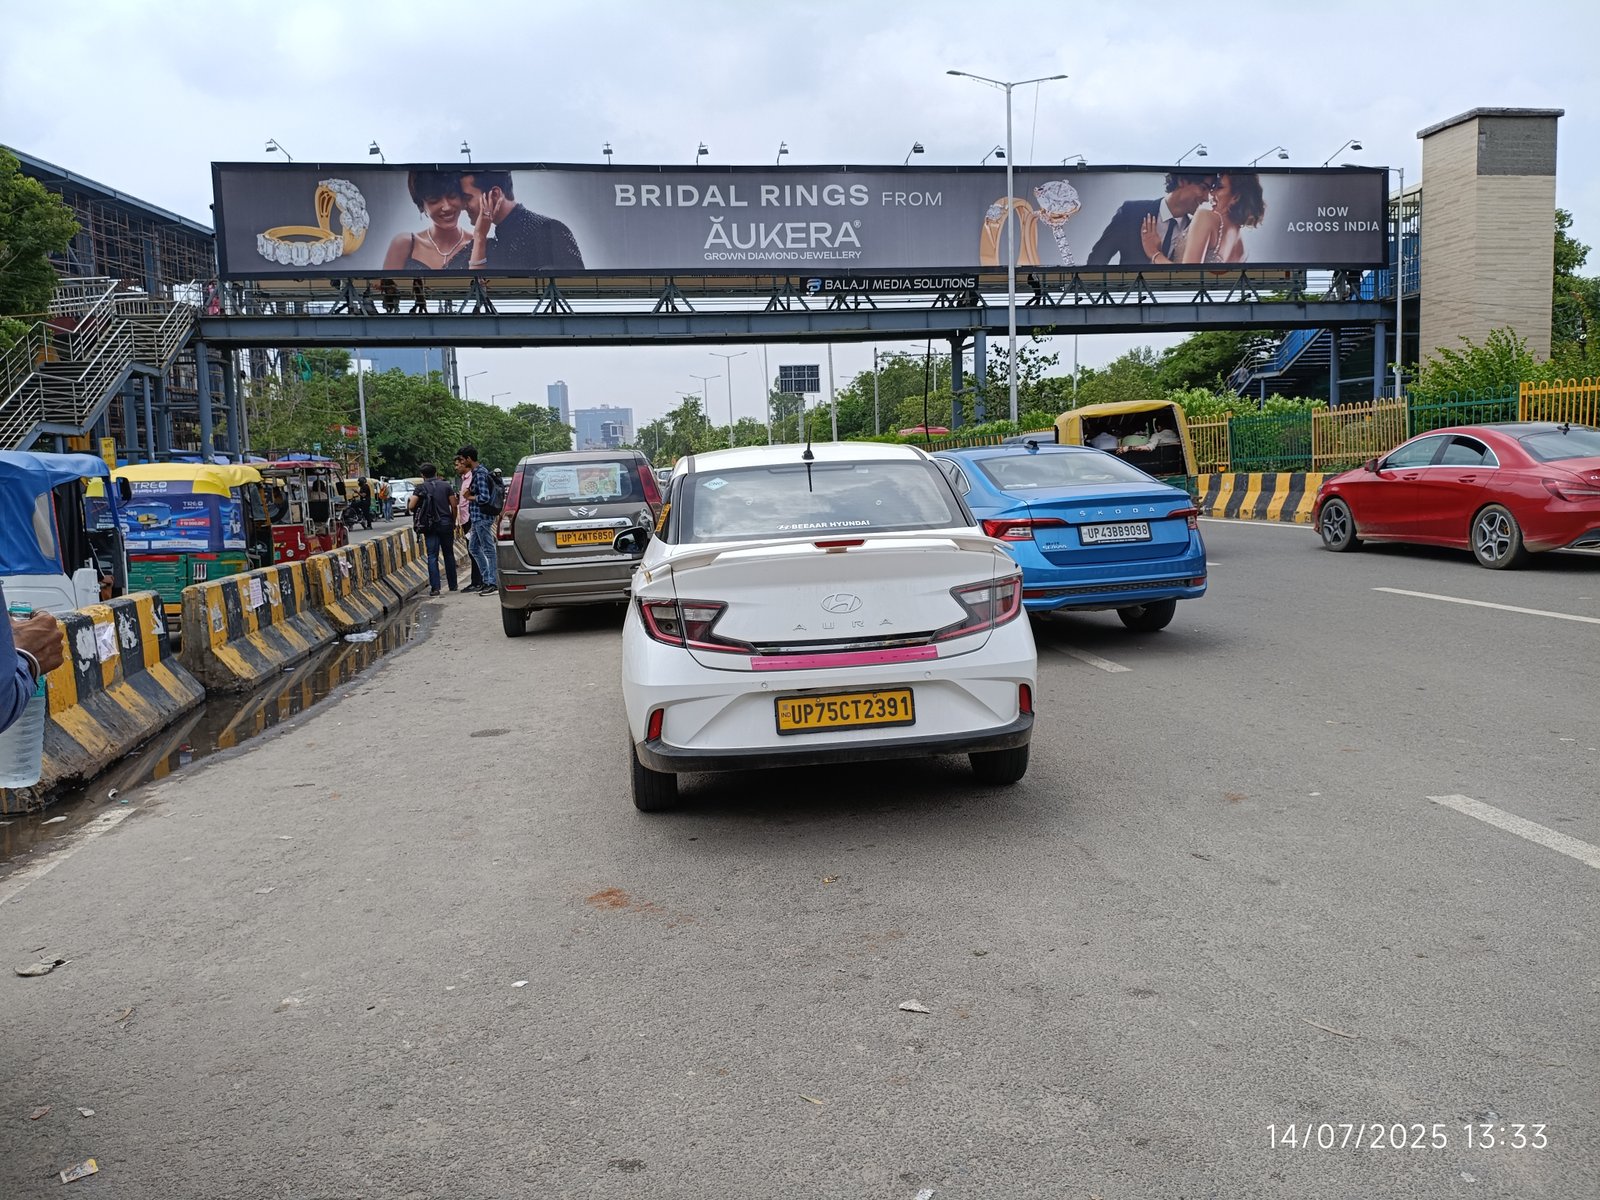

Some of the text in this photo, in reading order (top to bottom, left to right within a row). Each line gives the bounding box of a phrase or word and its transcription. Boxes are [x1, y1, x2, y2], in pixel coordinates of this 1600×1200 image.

[614, 184, 942, 207] BRIDAL RINGS FROM
[1317, 206, 1349, 217] NOW
[1287, 221, 1380, 232] ACROSS INDIA
[704, 251, 862, 261] GROWN DIAMOND JEWELLERY
[824, 277, 975, 290] BALAJI MEDIA SOLUTIONS
[132, 481, 168, 489] TREO
[1079, 506, 1156, 517] SKODA
[791, 520, 870, 530] BEEAAR HYUNDAI
[561, 530, 613, 543] UP14NT6850
[1087, 524, 1148, 539] UP43BB9098
[792, 618, 893, 631] AURA
[790, 696, 909, 725] UP75CT2391
